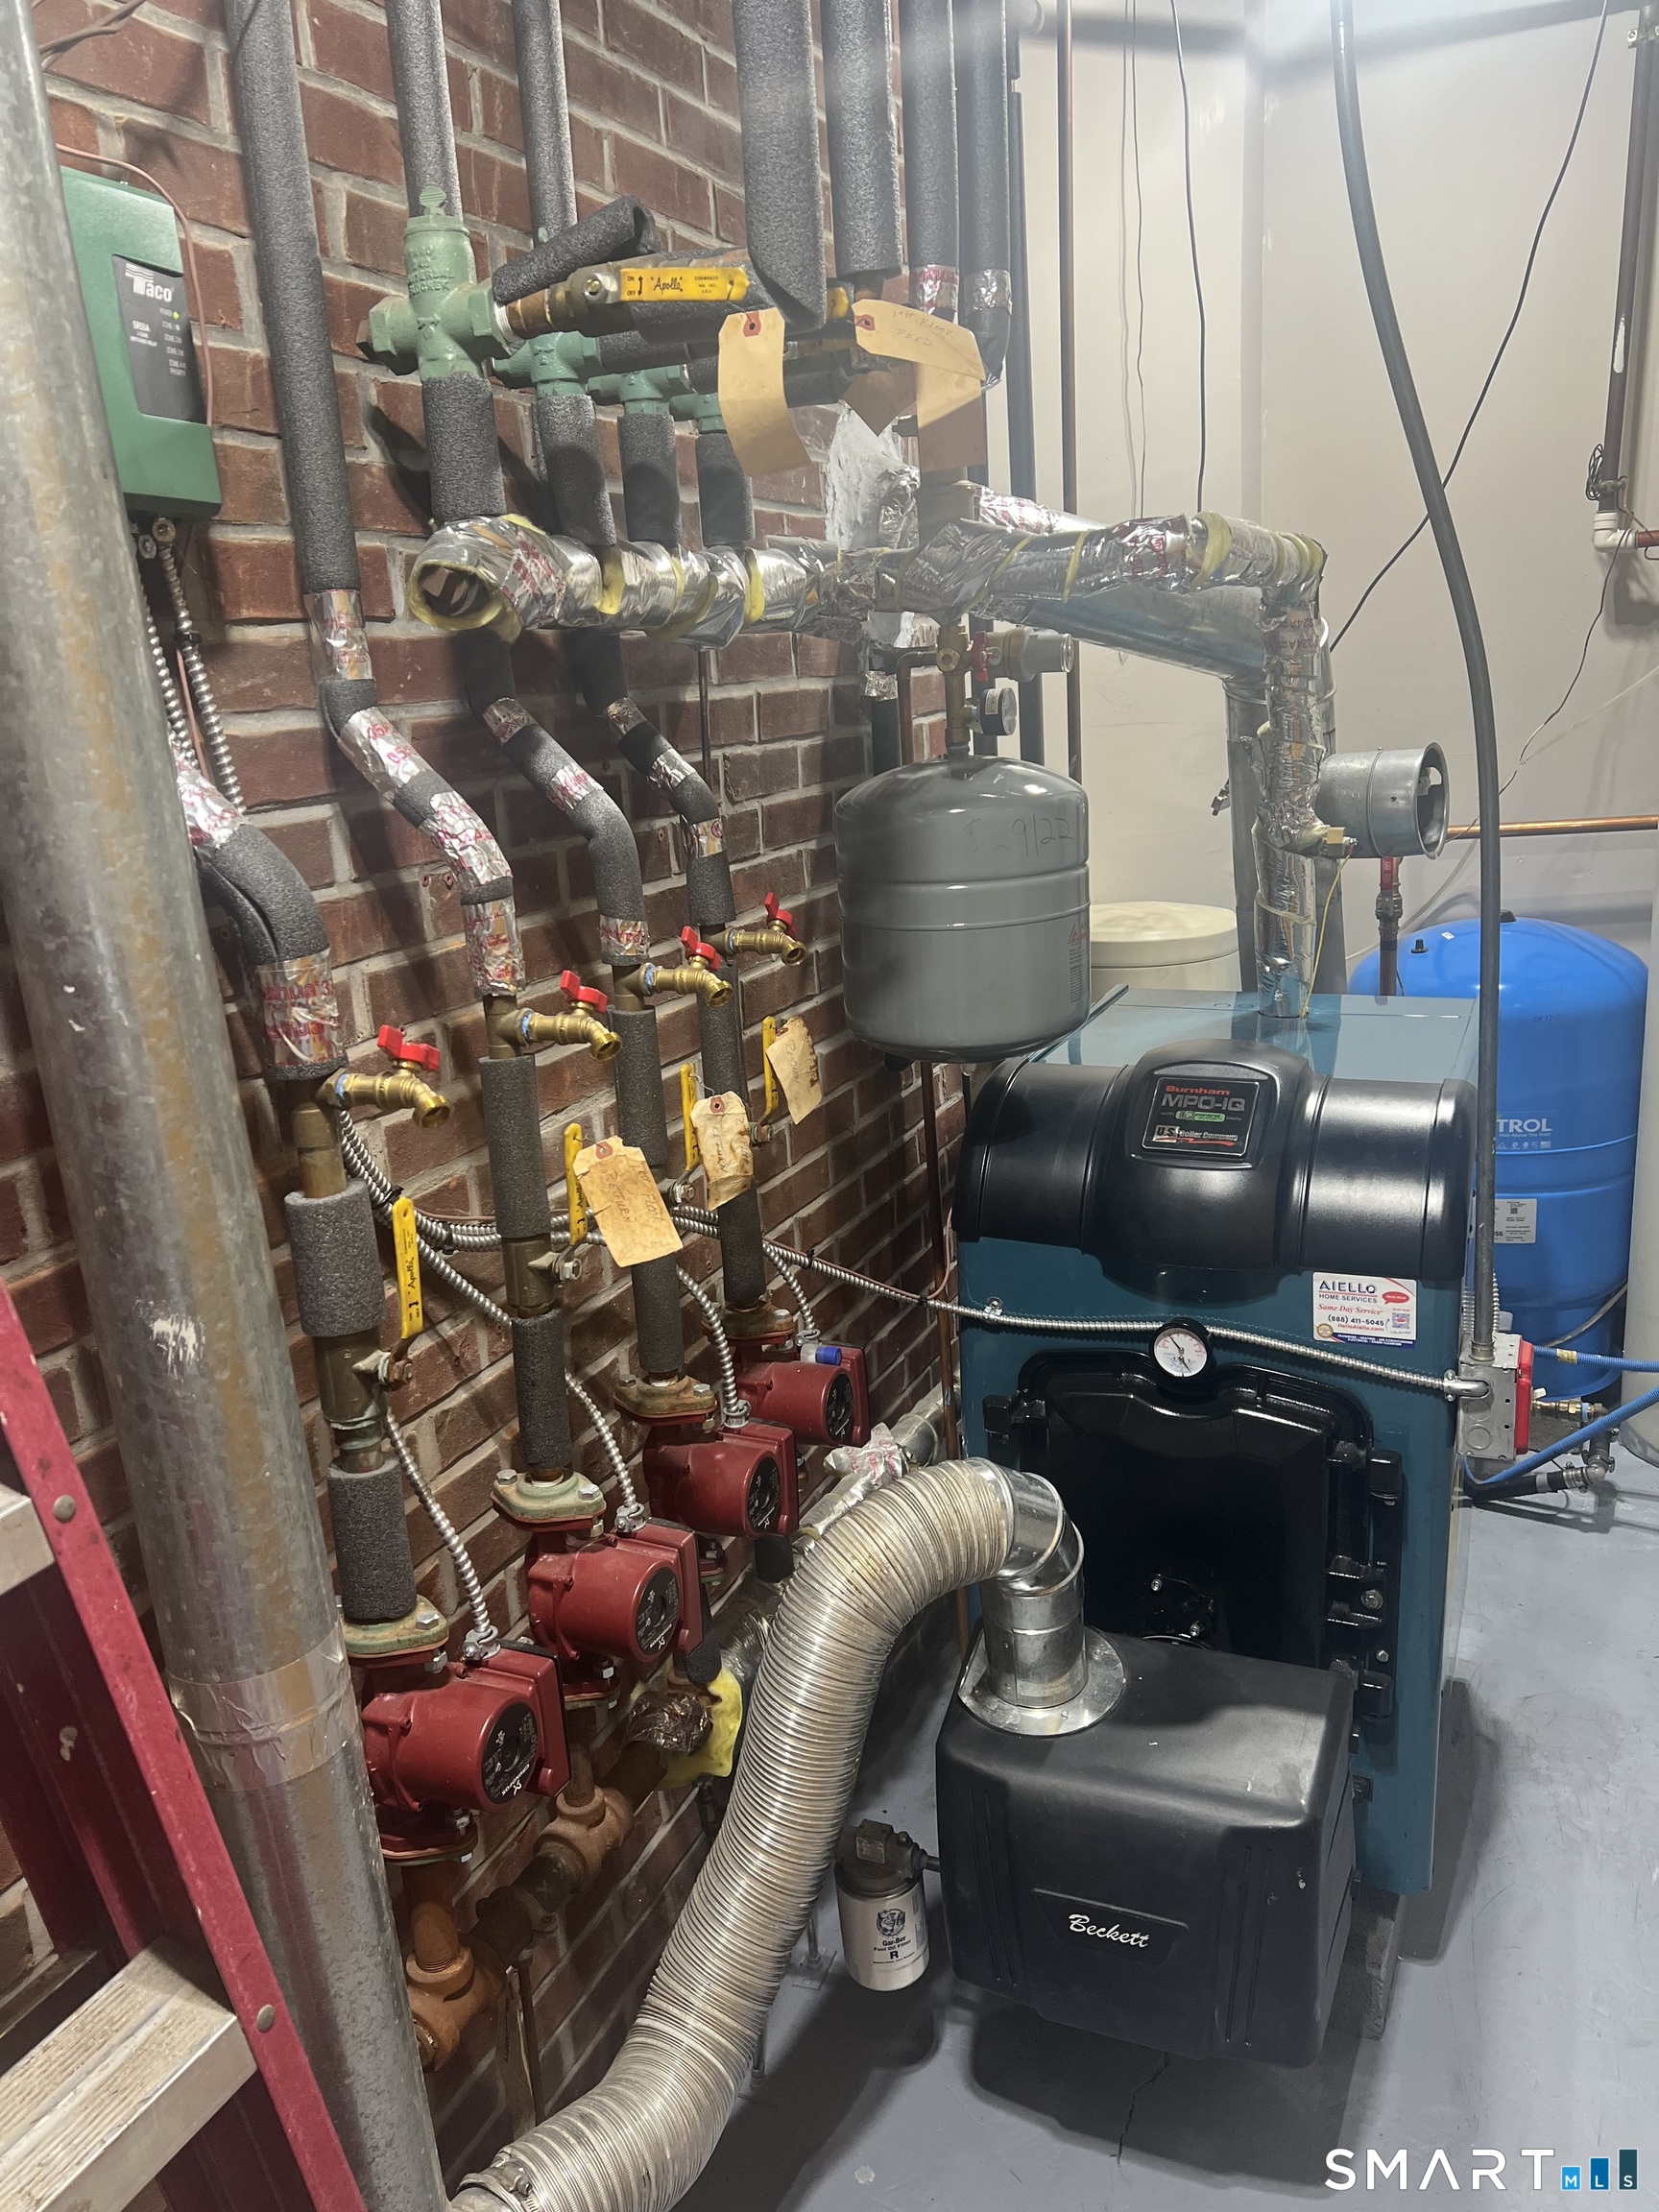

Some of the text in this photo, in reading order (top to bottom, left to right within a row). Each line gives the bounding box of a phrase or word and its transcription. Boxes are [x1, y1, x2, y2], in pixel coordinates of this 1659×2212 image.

[125, 263, 173, 302] Taco
[896, 327, 933, 347] FEED
[1166, 1085, 1230, 1095] Burnham
[1161, 1094, 1245, 1112] MPO-IQ
[1180, 1129, 1202, 1139] Boiler
[1203, 1132, 1238, 1141] Company
[606, 1170, 635, 1223] RETURN
[641, 1193, 665, 1223] FLOOR
[1319, 1281, 1376, 1294] AIELLO
[1342, 1295, 1378, 1304] SERVICES
[1339, 1305, 1353, 1313] Day
[1356, 1307, 1382, 1315] Service
[1328, 1314, 1384, 1327] (888) 411-5045
[1337, 1323, 1384, 1333] HelloAiello.com
[1069, 1913, 1150, 1948] Beckett
[898, 1939, 911, 1948] Filter
[890, 1951, 899, 1960] R
